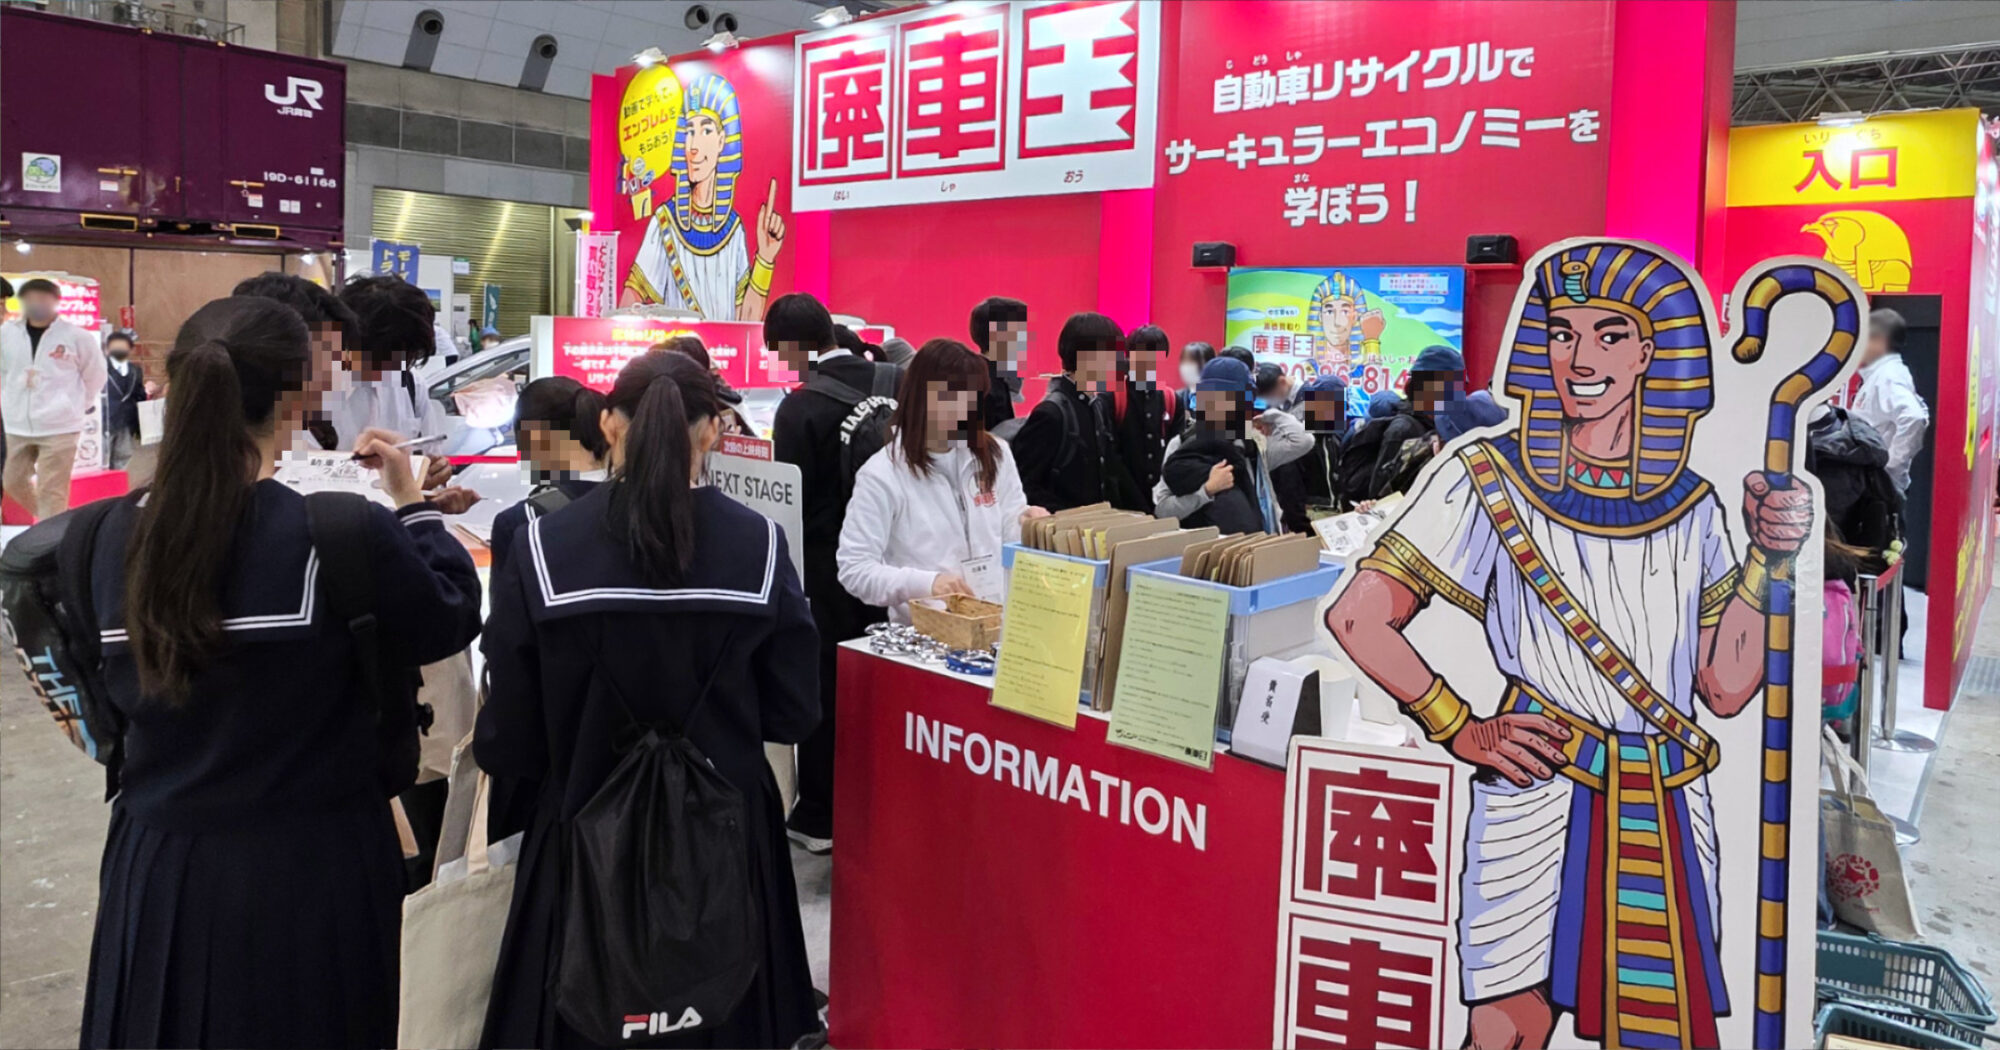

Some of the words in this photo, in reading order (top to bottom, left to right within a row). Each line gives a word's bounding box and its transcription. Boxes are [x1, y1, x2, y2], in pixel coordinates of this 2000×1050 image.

[1253, 53, 1269, 66] どう
[1286, 50, 1302, 62] しゃ
[264, 76, 324, 111] JR
[801, 0, 1138, 186] 廃車王
[1213, 41, 1535, 114] 自動車リサイクルで
[623, 106, 676, 142] エンブレムを
[1803, 130, 1832, 145] いり
[1164, 109, 1601, 175] サーキュラーエコノミーを
[263, 170, 338, 188] 19D-61168
[833, 190, 851, 202] はい
[940, 180, 957, 193] しゃ
[1063, 170, 1085, 184] おう
[1794, 146, 1899, 193] 入口
[1252, 333, 1315, 358] 廃車王
[744, 474, 794, 506] STAGE
[905, 711, 1207, 851] INFORMATION
[622, 1006, 703, 1040] FILA
